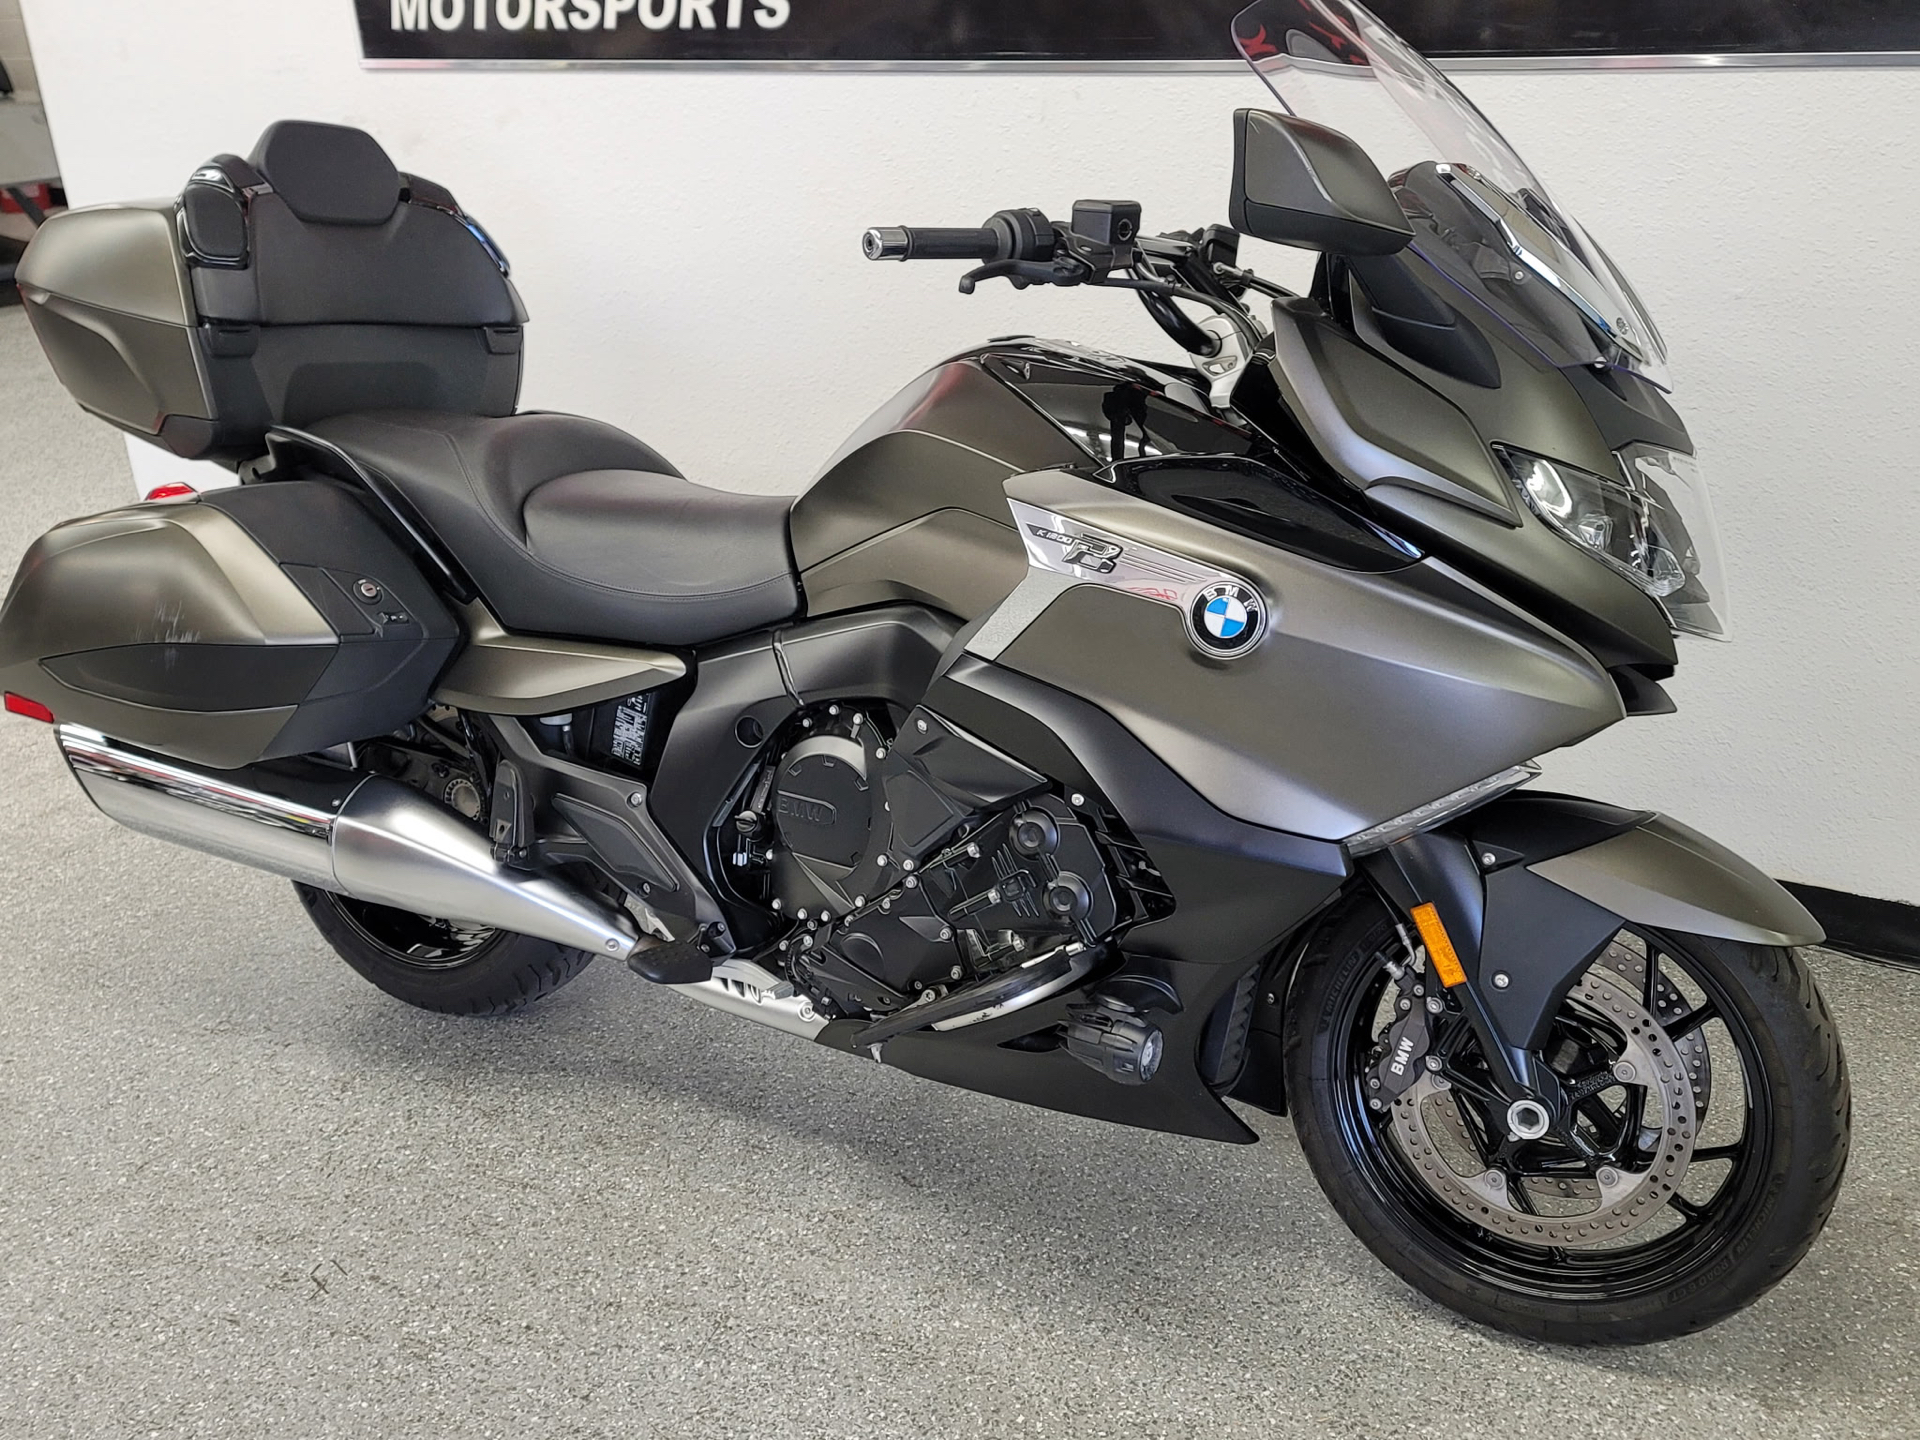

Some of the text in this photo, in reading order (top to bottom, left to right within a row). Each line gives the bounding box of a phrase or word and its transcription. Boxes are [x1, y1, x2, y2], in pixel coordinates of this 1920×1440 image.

[390, 0, 791, 31] MOTORSPORTS
[1202, 585, 1258, 613] BMW
[778, 797, 823, 822] BMW
[1325, 950, 1360, 1013] MICHELIN
[1390, 1036, 1414, 1076] BMW
